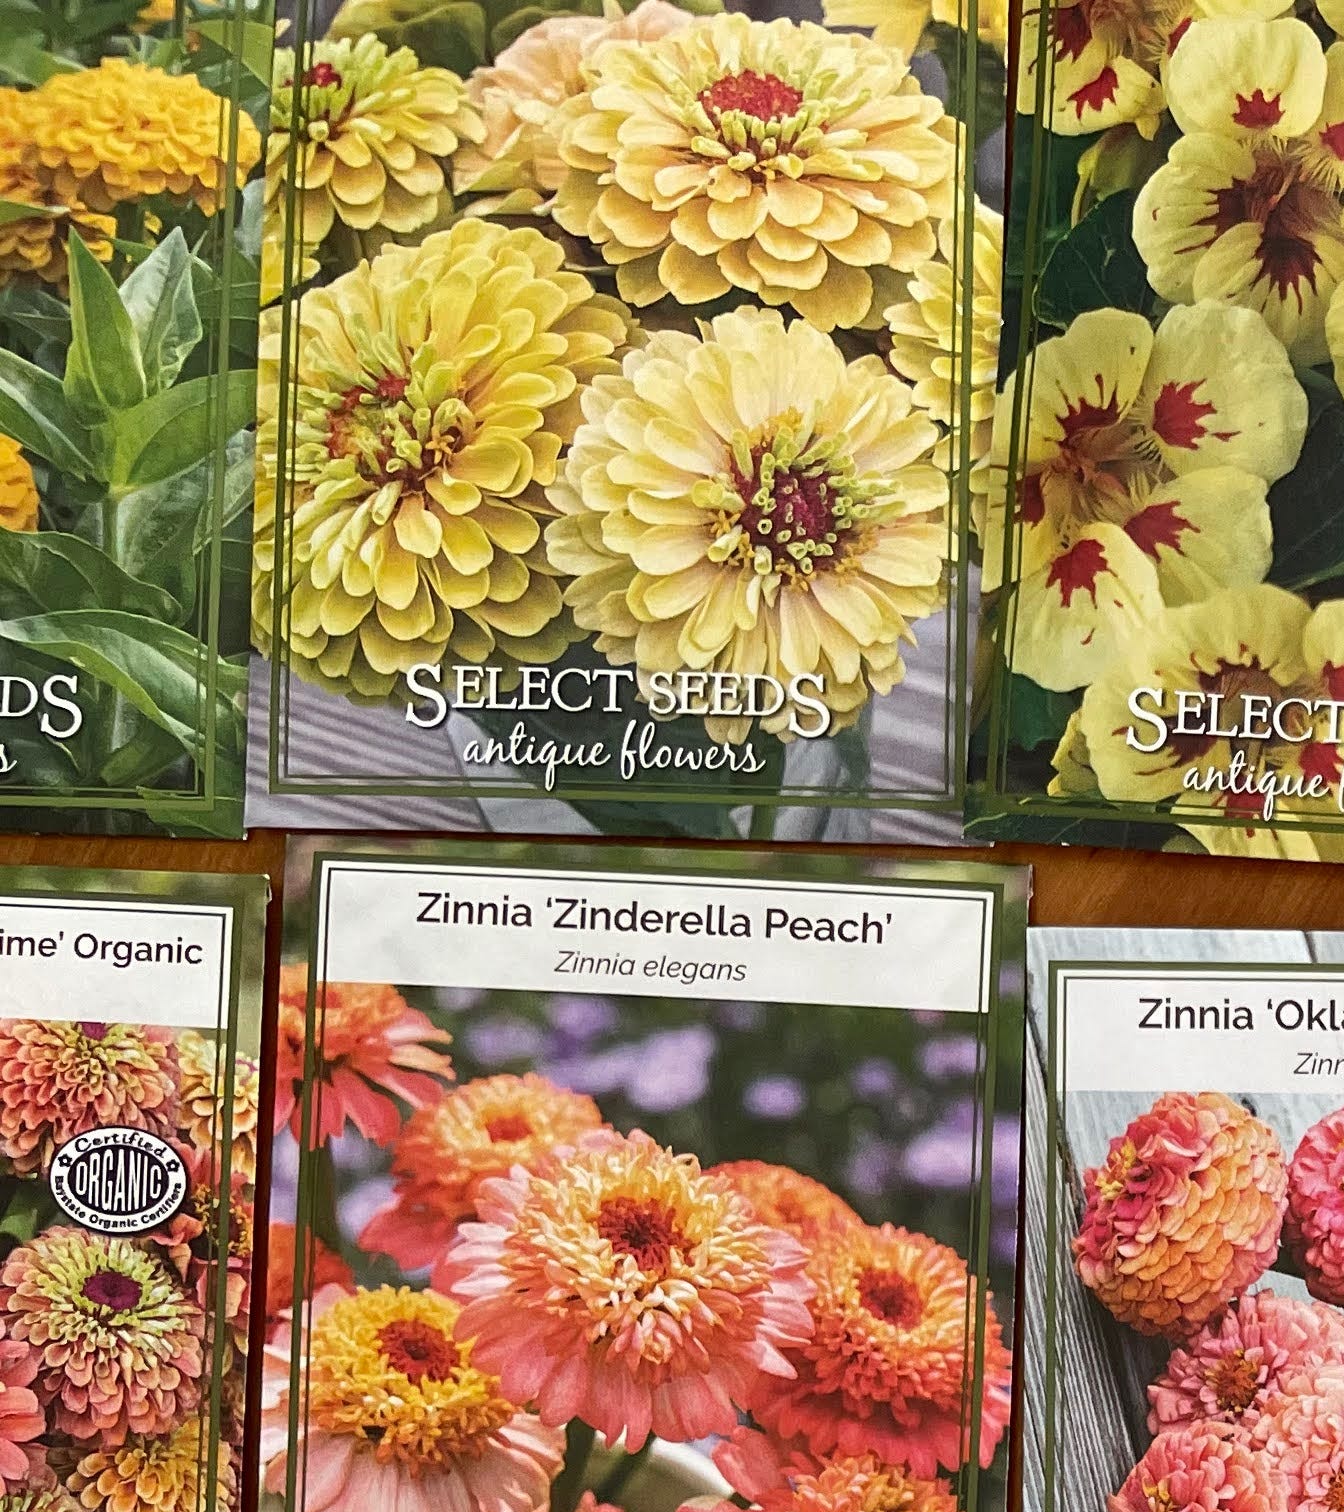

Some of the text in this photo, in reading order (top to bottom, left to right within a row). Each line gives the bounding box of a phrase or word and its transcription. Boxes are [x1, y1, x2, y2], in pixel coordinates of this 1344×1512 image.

[405, 664, 831, 738] SELECT SEEDS
[463, 720, 766, 792] antique flowers
[1182, 750, 1329, 820] antique
[417, 892, 892, 944] Zinnia ‘Zinderella Peach’
[74, 933, 203, 968] Organic
[554, 950, 747, 984] Zinnia elegans
[1138, 998, 1253, 1030] Zinnia
[75, 1132, 167, 1158] Certified
[76, 1149, 161, 1211] ORGANIC
